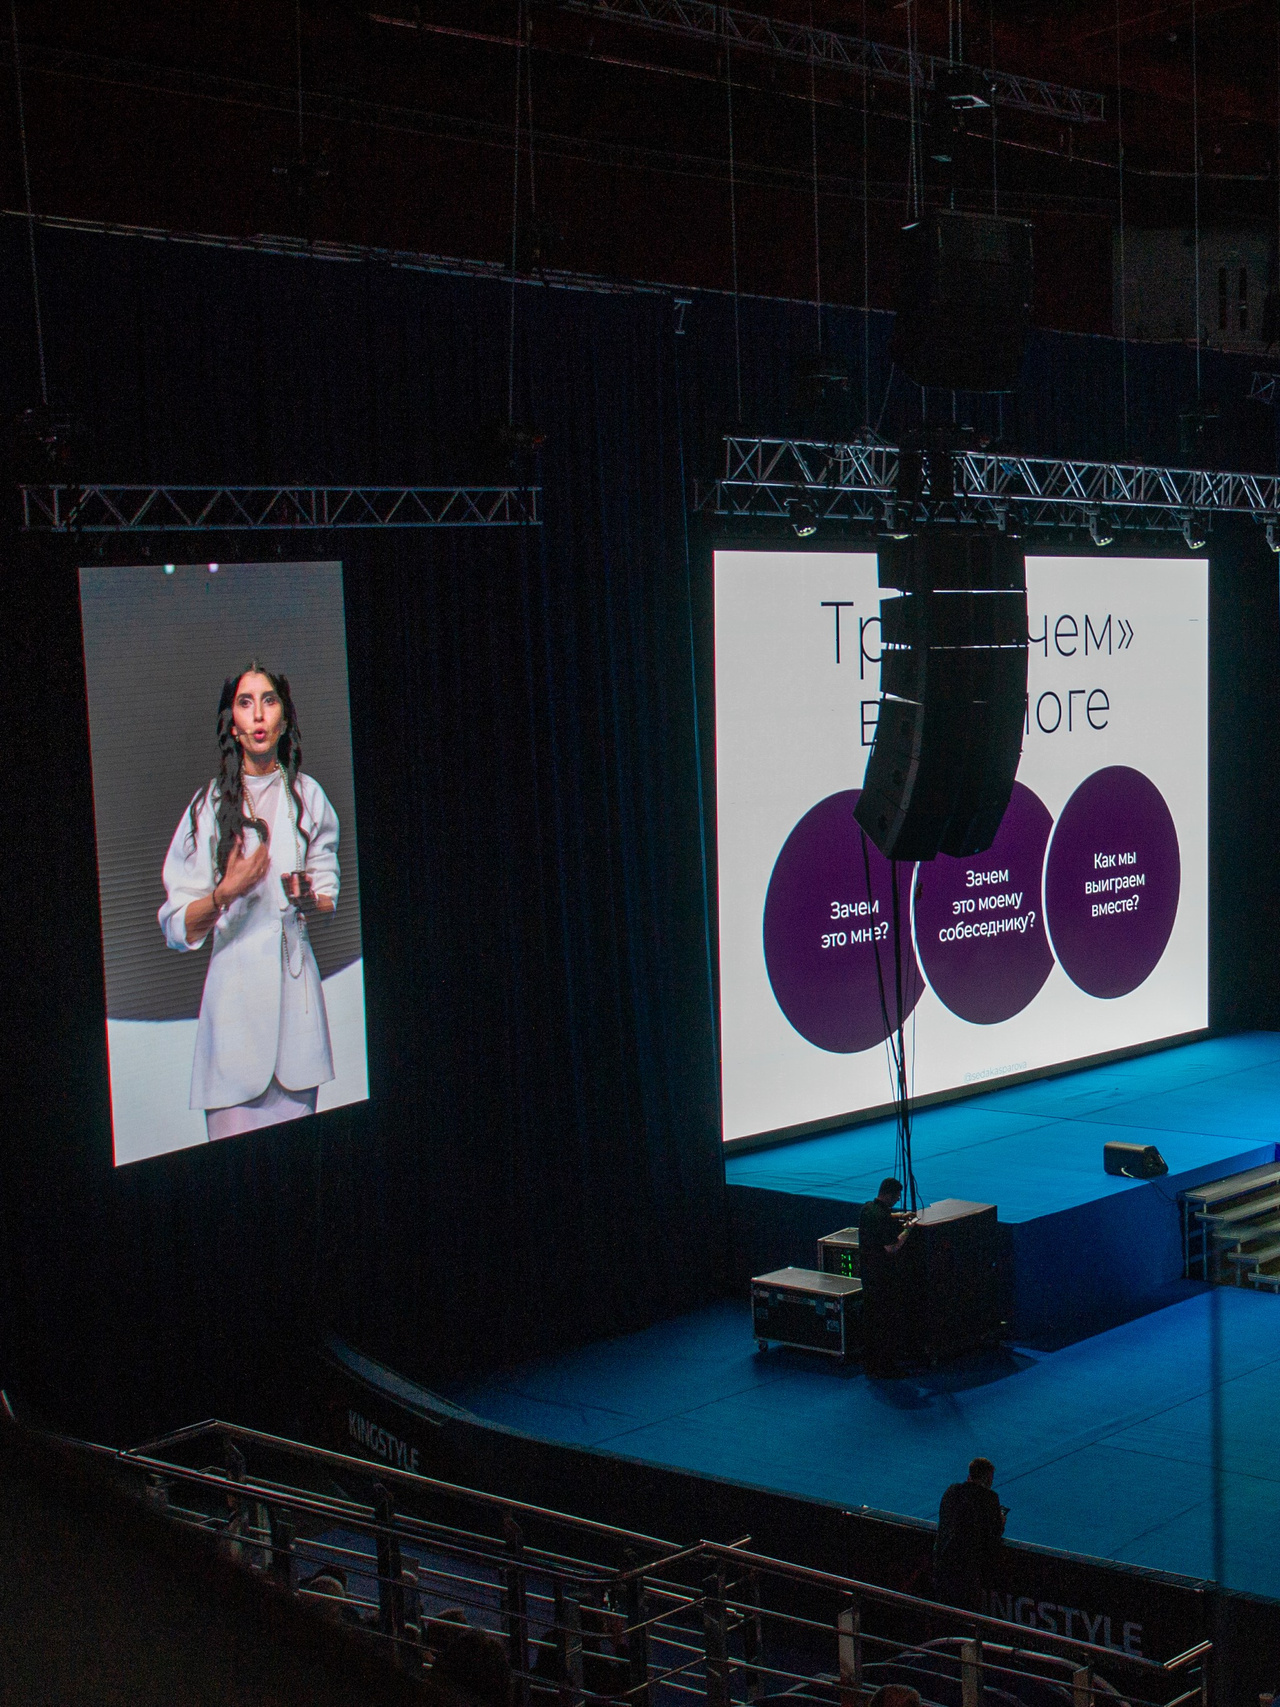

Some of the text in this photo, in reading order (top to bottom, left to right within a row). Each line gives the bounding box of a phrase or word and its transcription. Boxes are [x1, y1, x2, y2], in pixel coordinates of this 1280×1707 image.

[821, 601, 1135, 680] Тр чем»
[1094, 851, 1137, 869] Как мы
[965, 868, 1009, 888] Зачем
[1085, 873, 1145, 894] выиграем
[830, 900, 879, 920] Зачем
[952, 891, 1023, 915] это моему
[1091, 895, 1140, 917] вместе?
[821, 922, 889, 949] это мне?
[939, 911, 1036, 942] собеседнику?
[964, 1061, 1027, 1082] @sedakasparova
[349, 1410, 420, 1474] KINGSTYLE
[980, 1588, 1143, 1657] INGSTYLE
